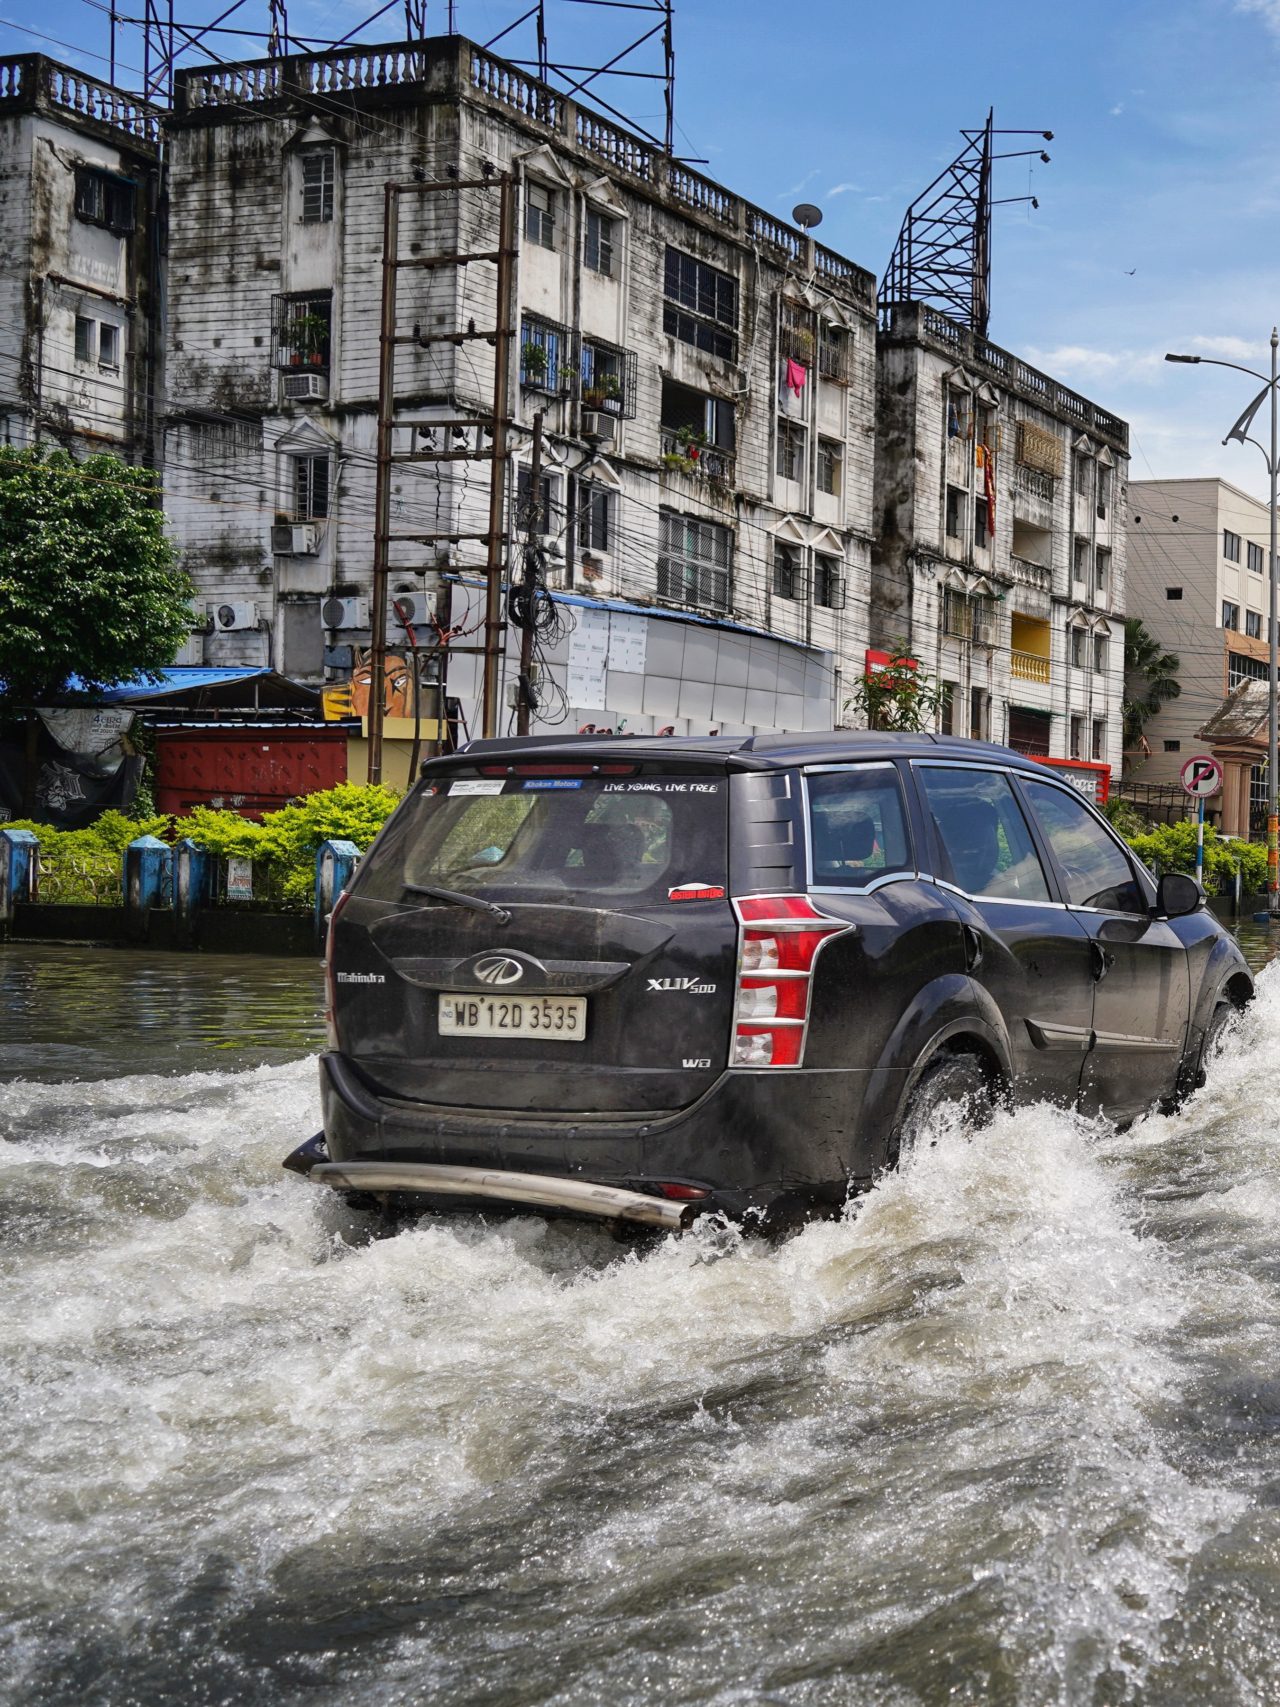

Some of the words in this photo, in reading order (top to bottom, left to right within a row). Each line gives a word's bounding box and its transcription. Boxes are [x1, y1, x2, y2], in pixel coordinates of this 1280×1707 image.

[526, 780, 552, 788] Khokan
[554, 780, 578, 788] Motors
[603, 783, 625, 792] LIVE
[665, 783, 688, 793] LIVE
[336, 971, 386, 983] Mahindra
[455, 1002, 479, 1027] WB
[487, 1003, 522, 1028] 12D
[530, 1004, 578, 1030] 3535
